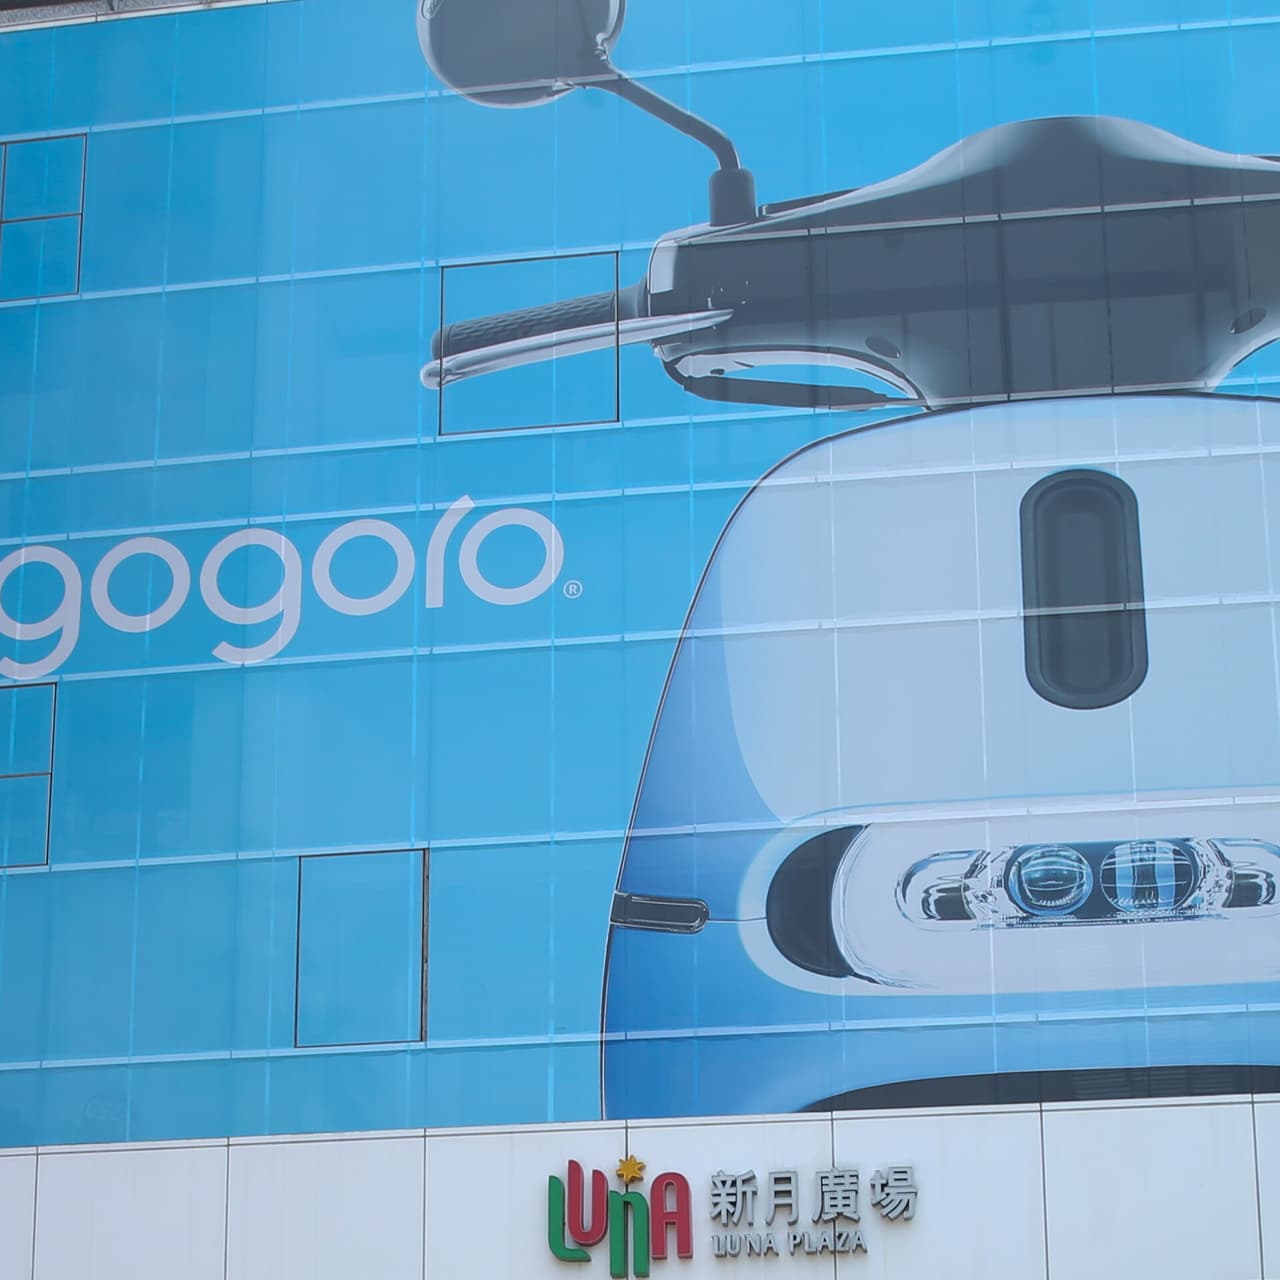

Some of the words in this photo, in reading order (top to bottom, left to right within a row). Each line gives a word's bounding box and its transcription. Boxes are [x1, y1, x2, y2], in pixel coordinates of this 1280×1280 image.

[709, 1165, 920, 1227] 新月廣場
[711, 1231, 780, 1258] LUNA
[788, 1229, 869, 1257] PLAZA
